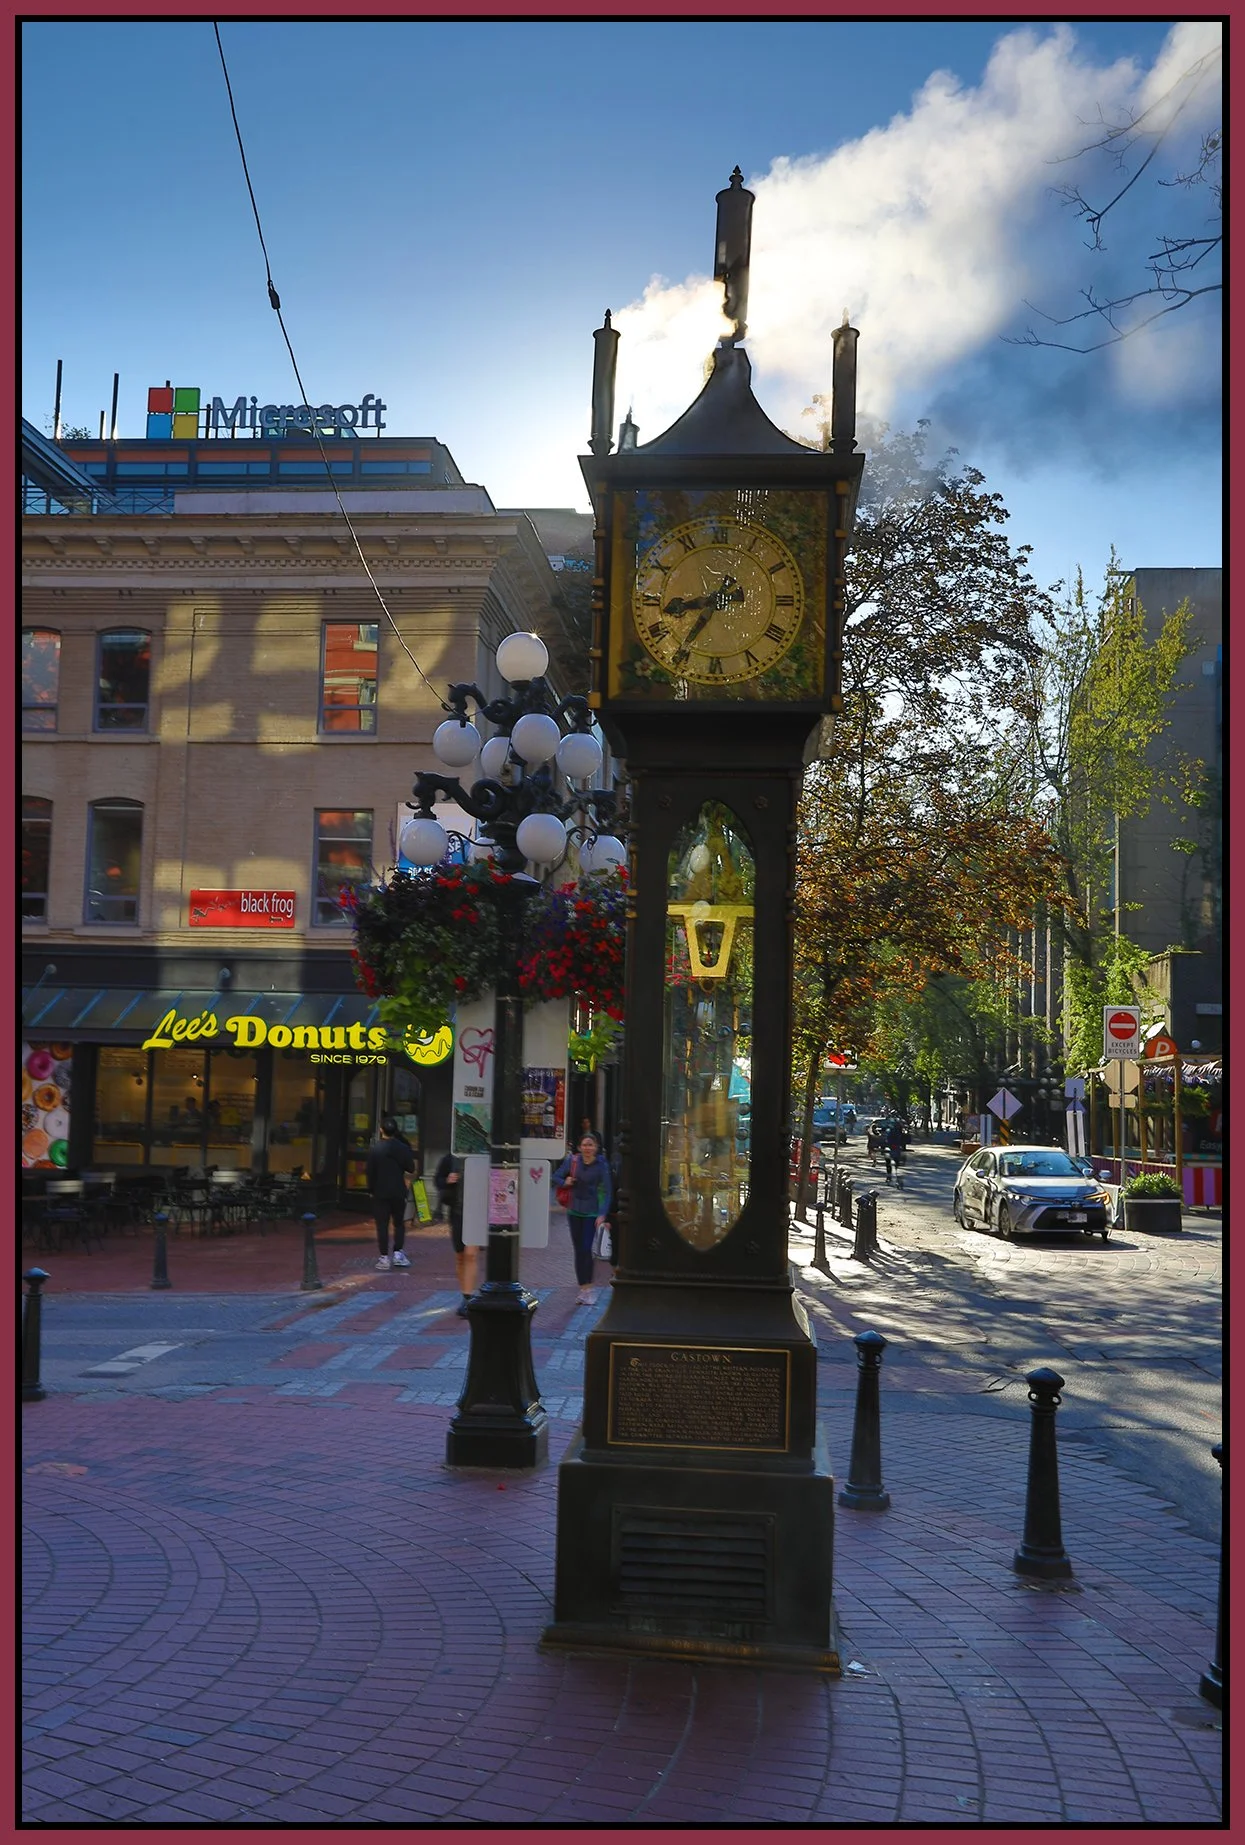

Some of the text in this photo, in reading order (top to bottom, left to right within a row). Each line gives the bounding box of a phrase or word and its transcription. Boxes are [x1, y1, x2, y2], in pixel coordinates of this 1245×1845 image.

[211, 393, 387, 428] Microsoft
[241, 893, 294, 918] black frog
[142, 1009, 388, 1050] Lee's Donuts
[310, 1054, 388, 1065] SINCE 1979
[670, 1352, 732, 1364] GASTOWN
